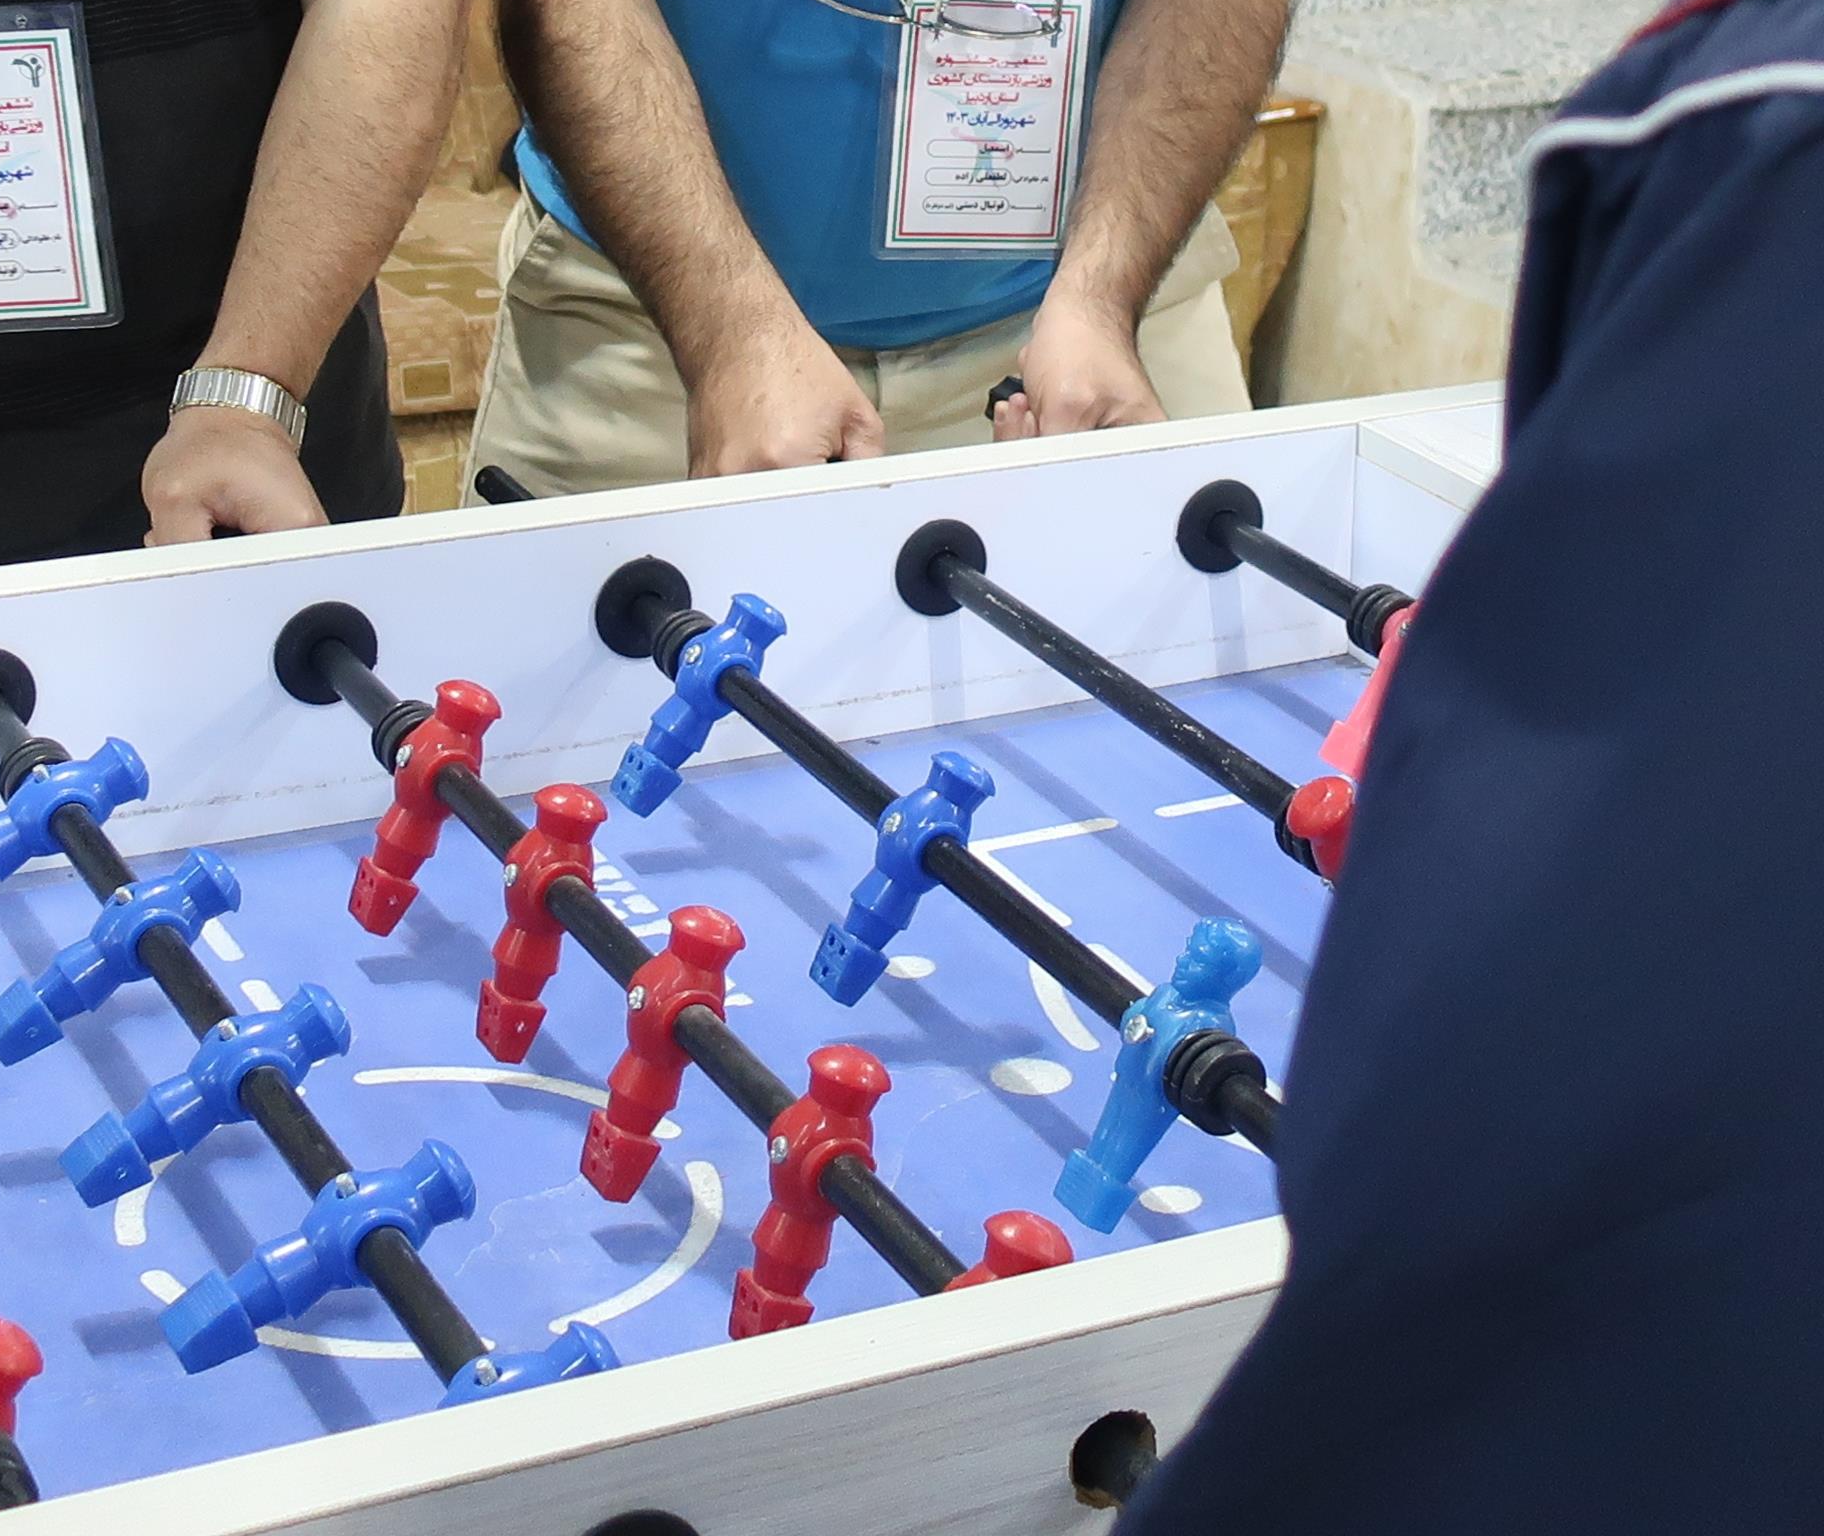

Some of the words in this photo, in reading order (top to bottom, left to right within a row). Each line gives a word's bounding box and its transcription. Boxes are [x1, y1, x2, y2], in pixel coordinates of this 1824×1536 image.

[936, 53, 998, 68] جشنواره
[997, 54, 1048, 69] ششمین
[927, 72, 964, 86] کشوری
[964, 72, 1022, 88] بازنشستگان
[1021, 73, 1053, 89] ورزشی
[990, 91, 1020, 105] استان
